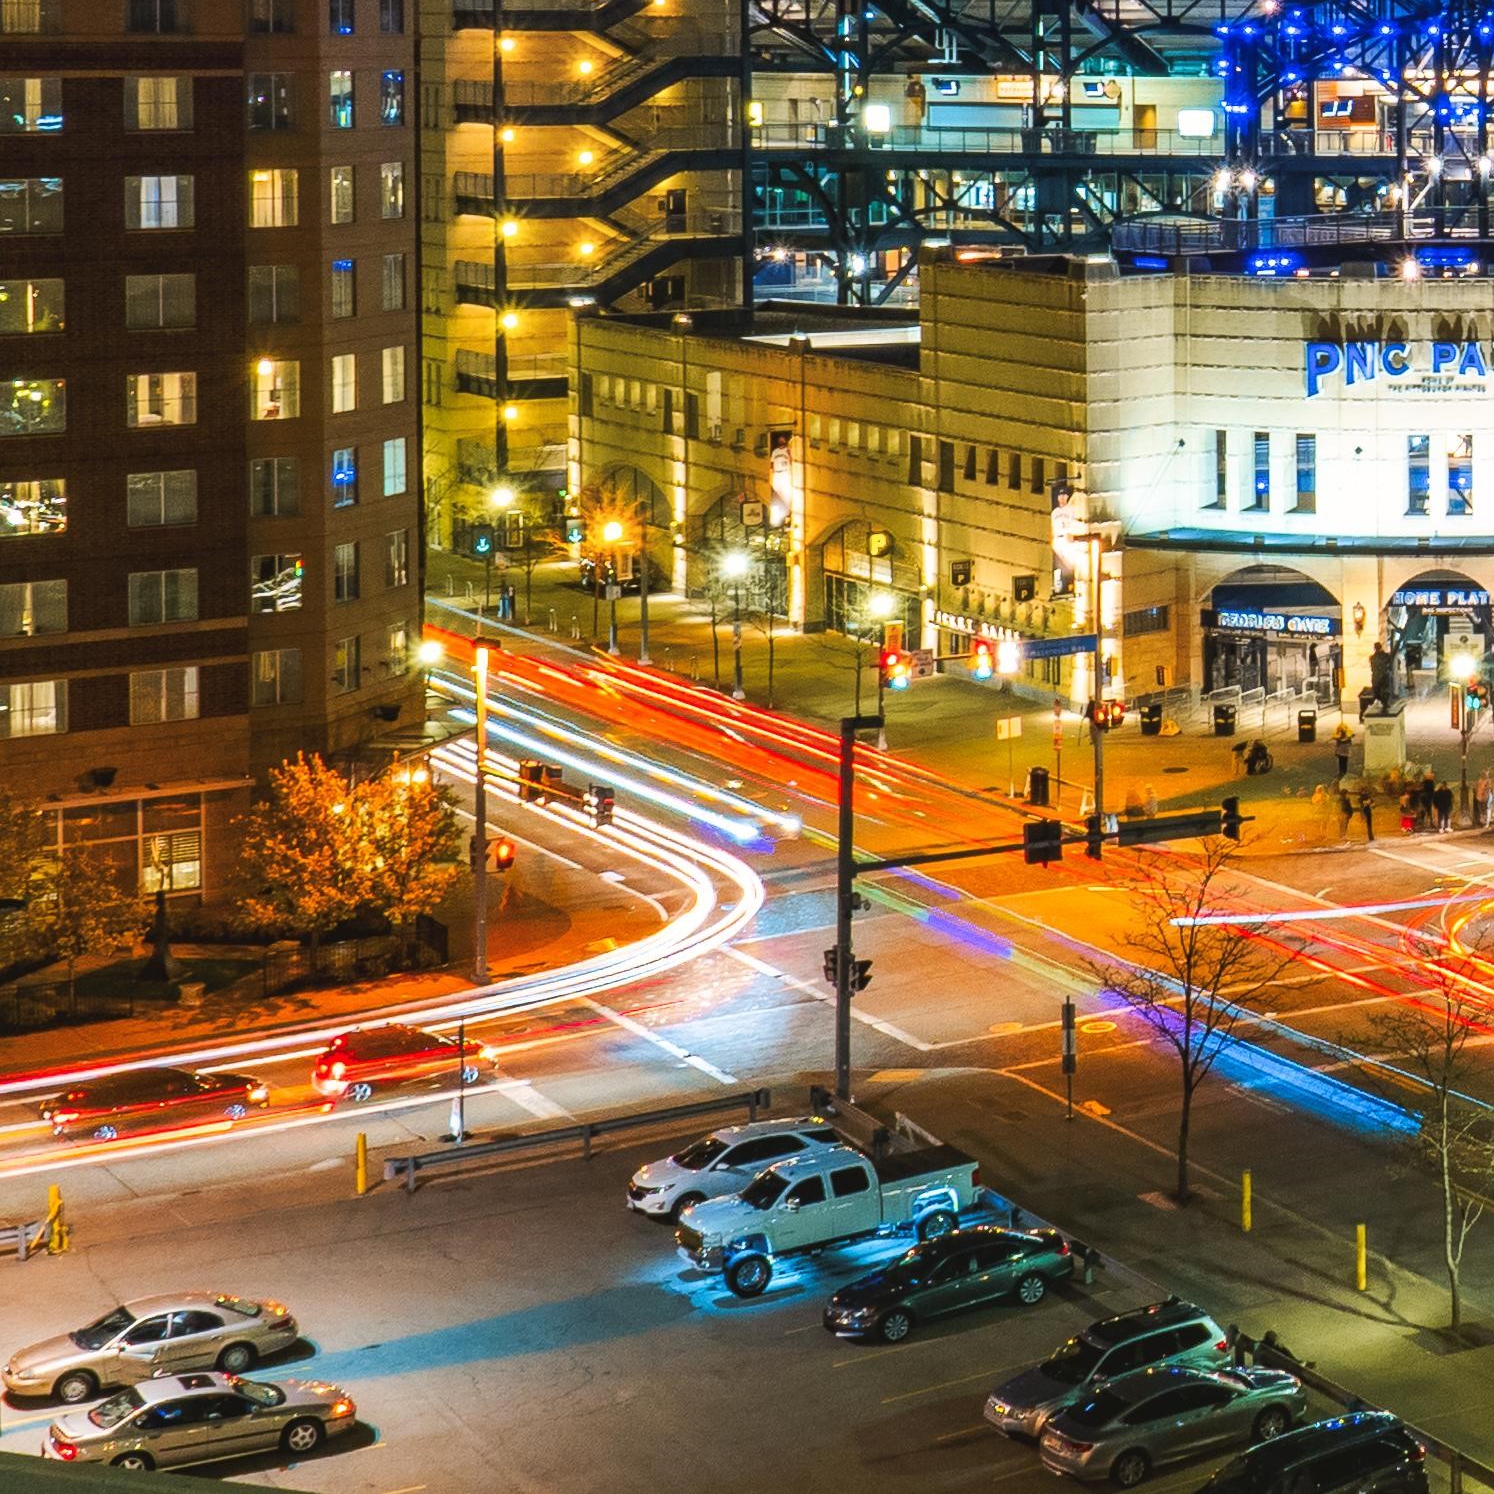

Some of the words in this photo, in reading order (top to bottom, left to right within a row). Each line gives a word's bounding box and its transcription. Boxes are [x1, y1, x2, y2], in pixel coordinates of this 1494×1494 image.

[1304, 339, 1412, 399] PNC
[1393, 591, 1440, 605] HOME
[1447, 592, 1494, 605] PLAT
